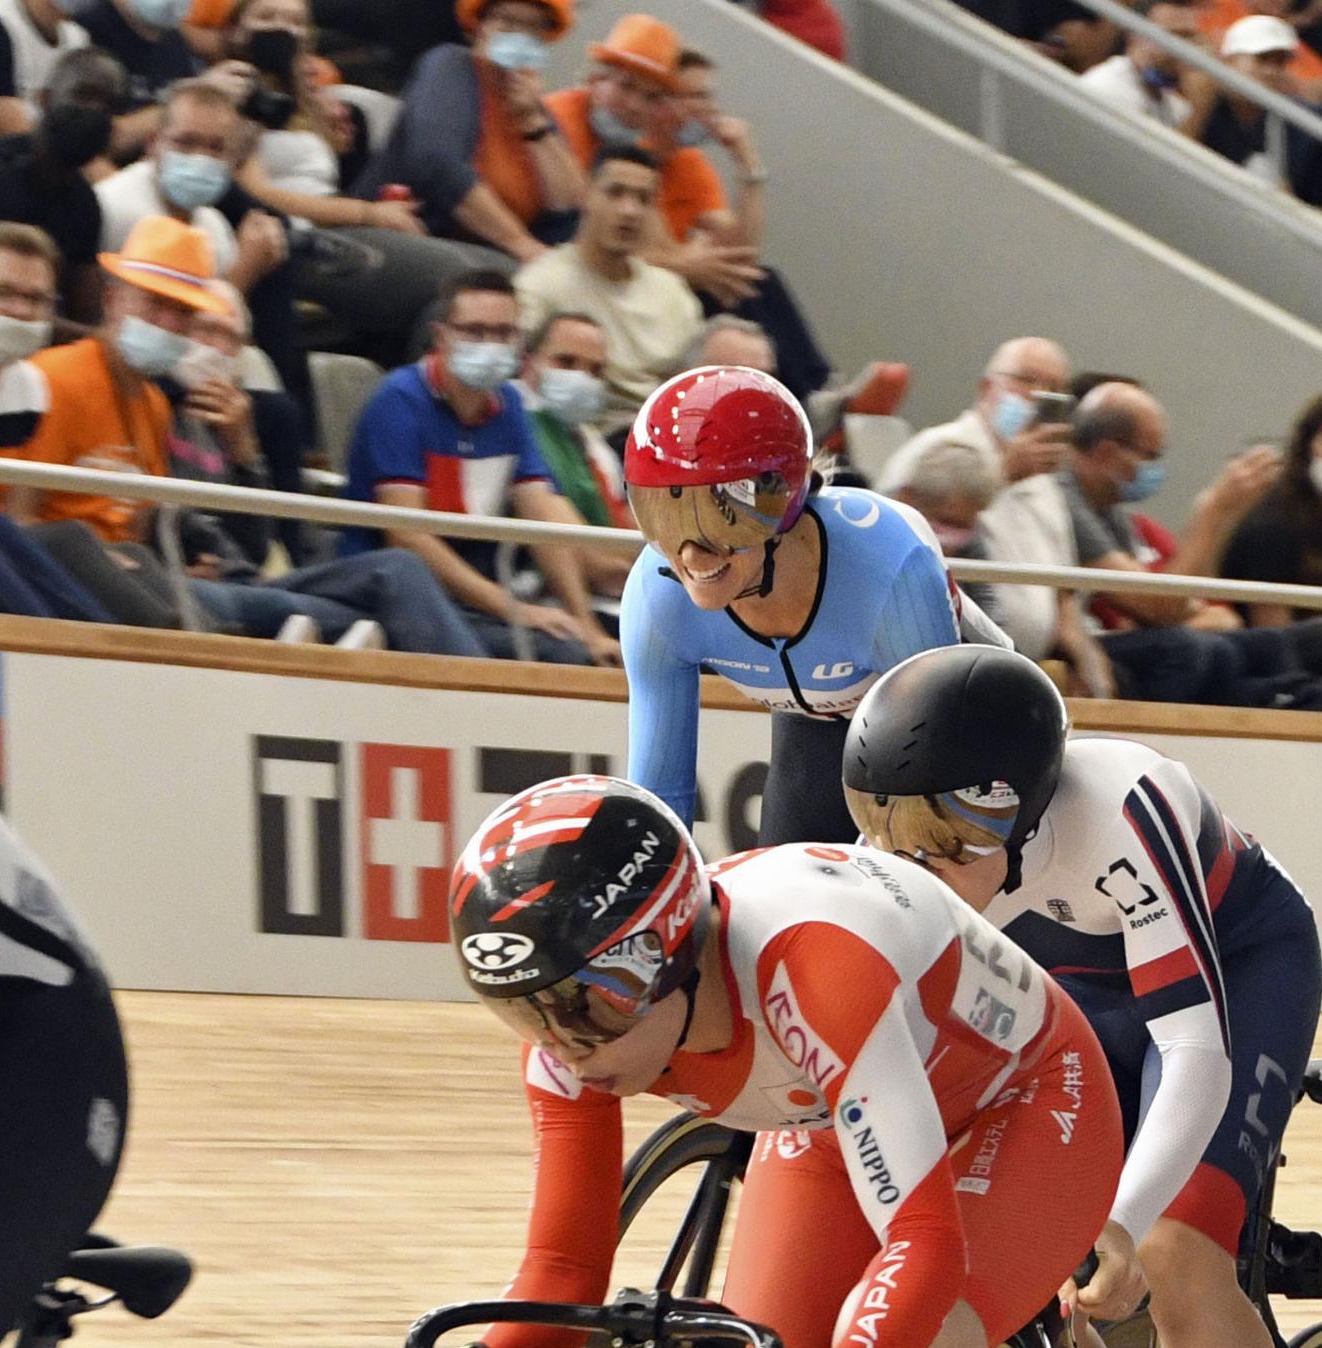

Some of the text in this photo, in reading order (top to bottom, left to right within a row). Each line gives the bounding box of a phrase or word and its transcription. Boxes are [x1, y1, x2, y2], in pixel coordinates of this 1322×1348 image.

[591, 831, 660, 920] JAPAN
[1130, 907, 1169, 931] Rostec
[854, 1126, 901, 1206] NIPPO
